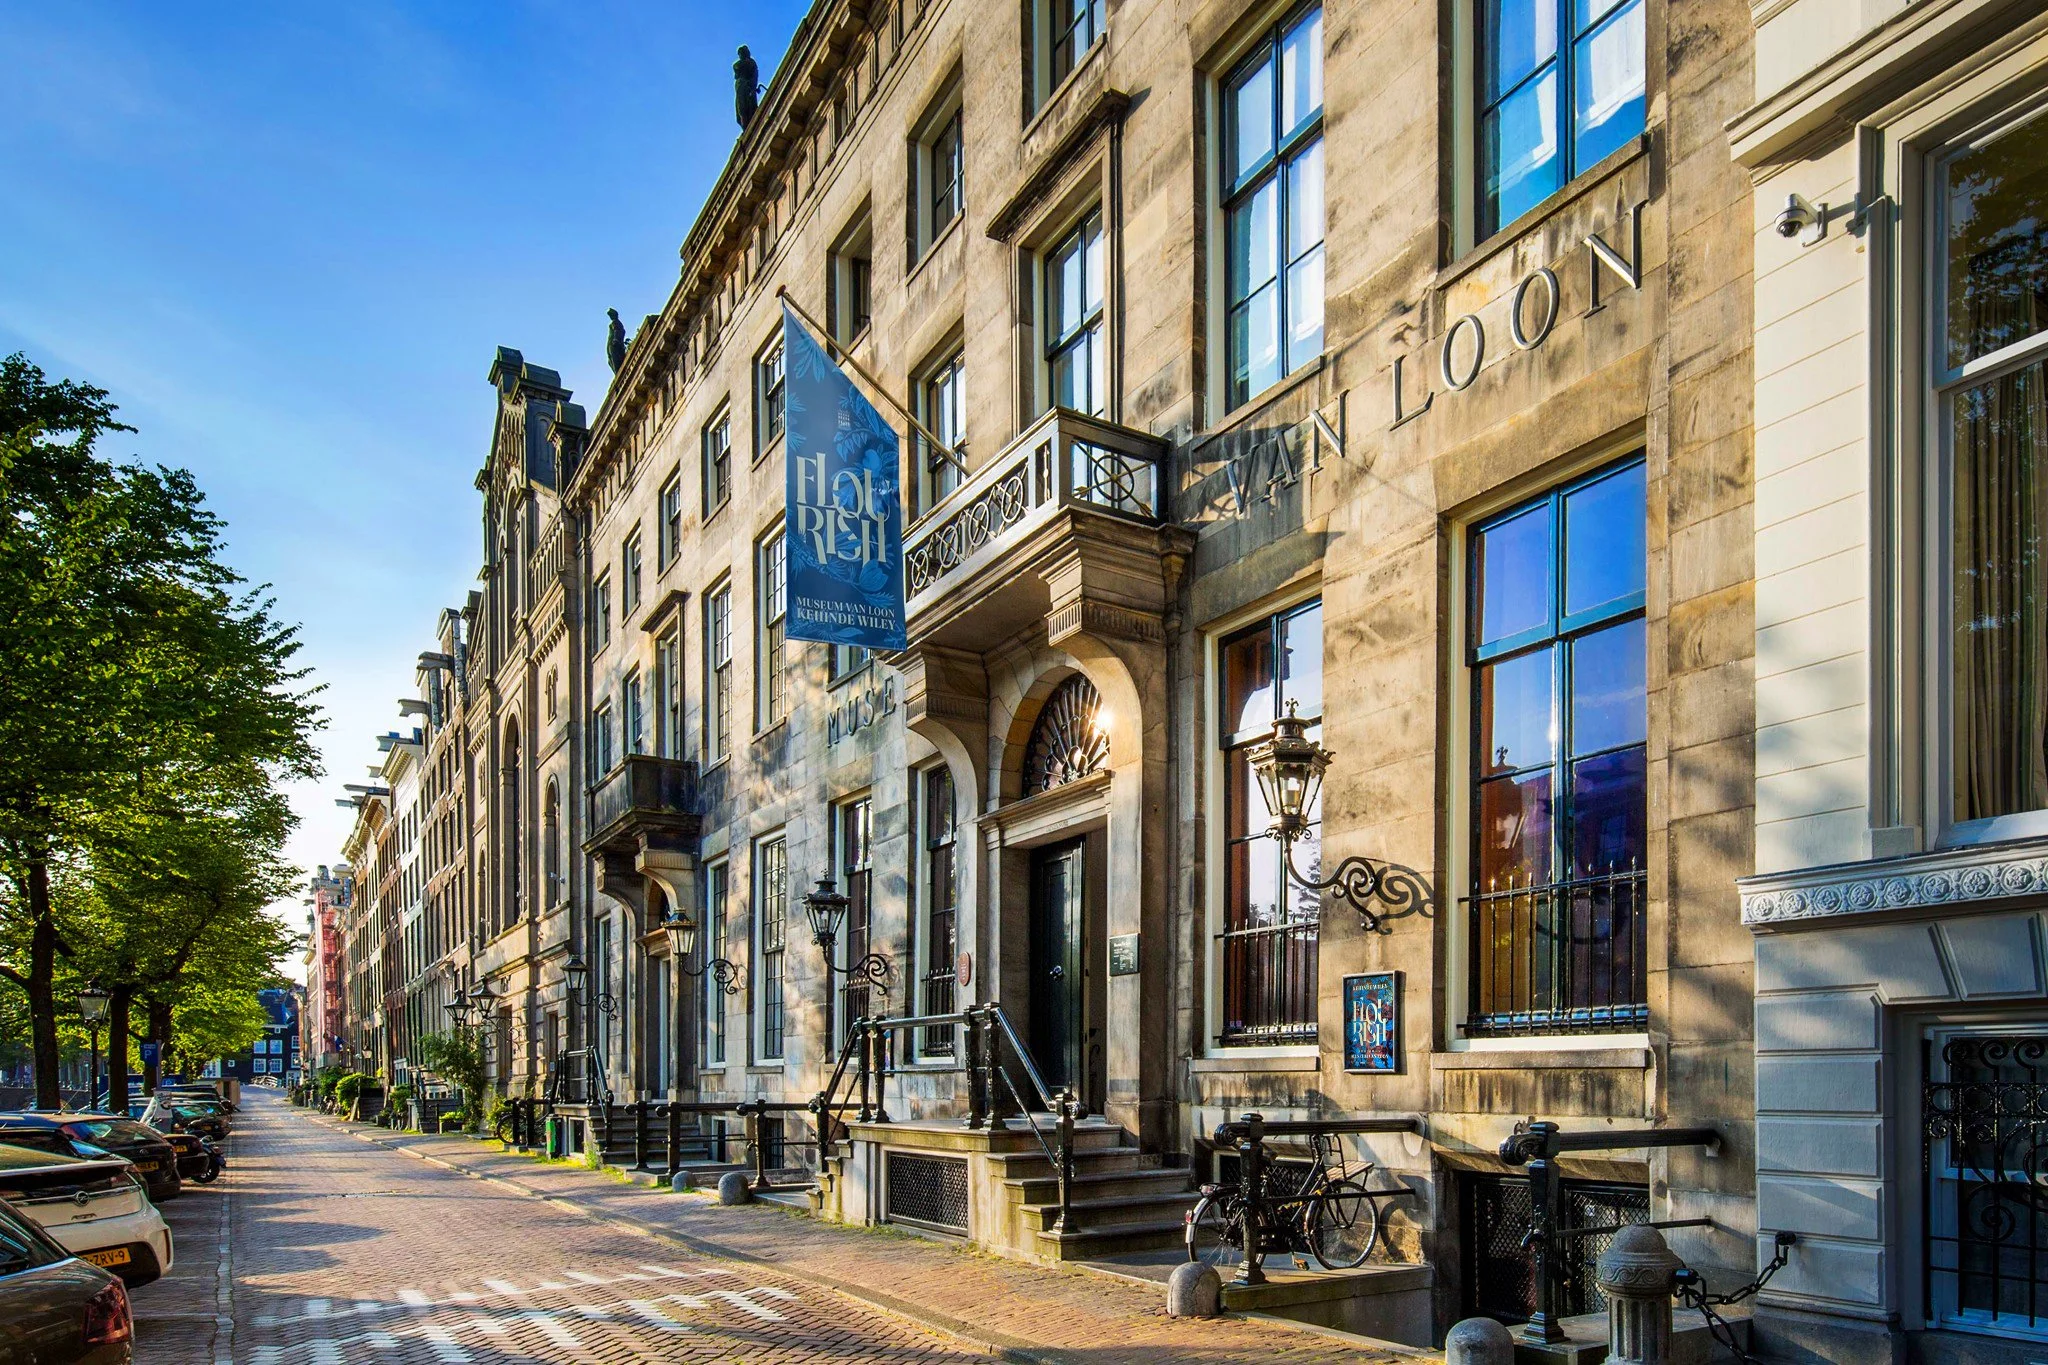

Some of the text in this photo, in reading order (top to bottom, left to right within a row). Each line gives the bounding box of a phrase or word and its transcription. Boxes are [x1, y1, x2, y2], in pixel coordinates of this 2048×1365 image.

[1226, 199, 1649, 515] VAN LOON
[797, 596, 895, 618] MUSEUM VAN LOON
[797, 607, 896, 631] KEHINDE WILEY
[827, 675, 897, 749] MUSE
